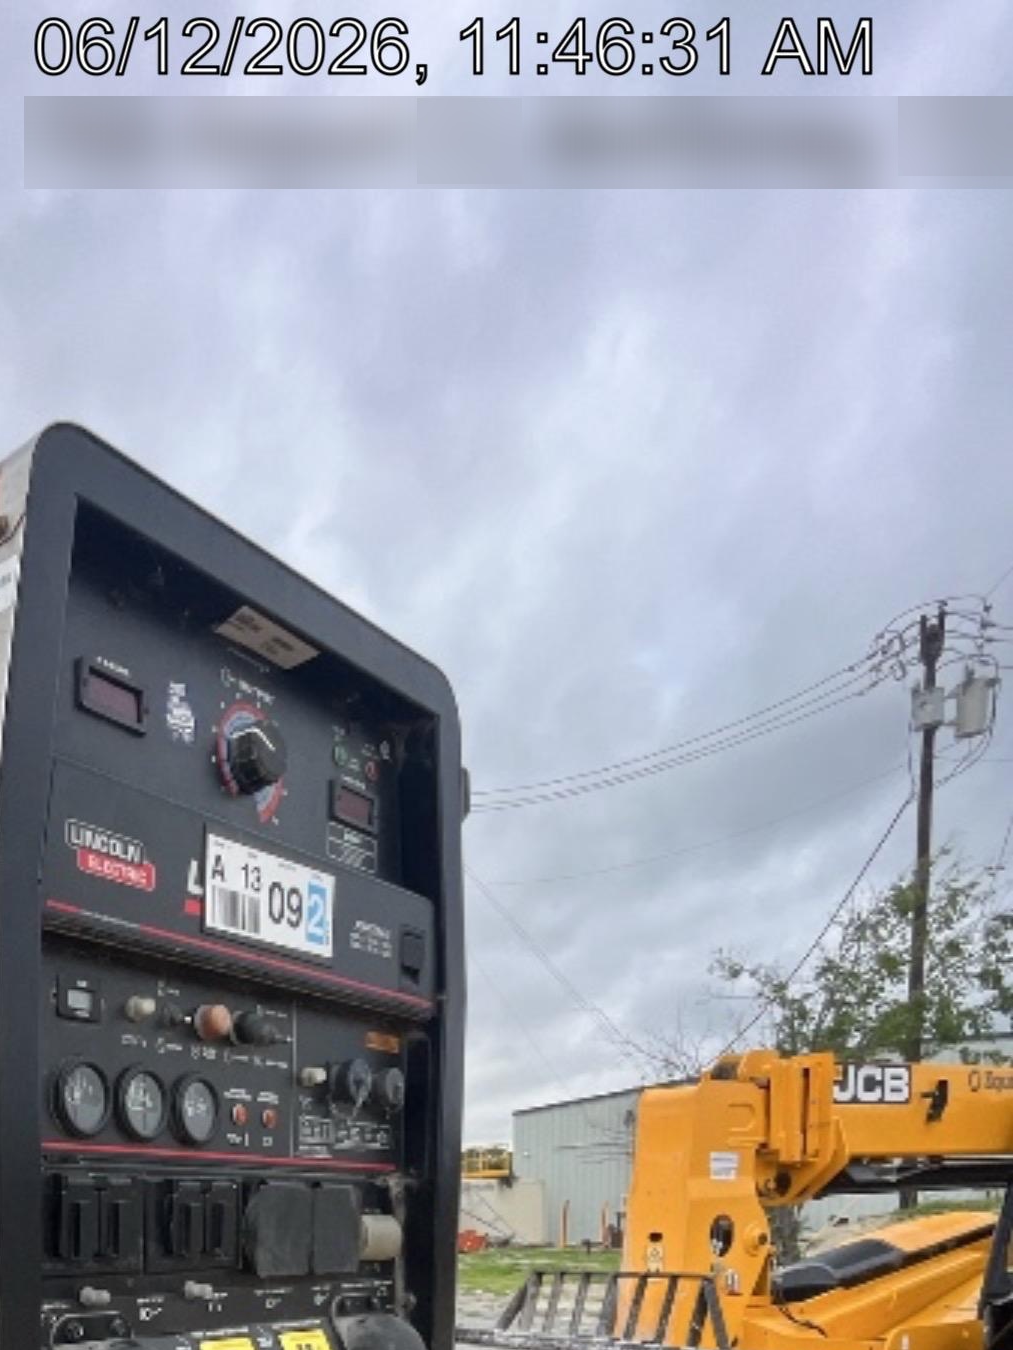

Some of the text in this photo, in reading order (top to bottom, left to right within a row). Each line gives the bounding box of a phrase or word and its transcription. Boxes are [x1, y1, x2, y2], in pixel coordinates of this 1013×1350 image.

[70, 823, 141, 865] LINCOLN
[211, 854, 226, 882] A
[240, 862, 262, 892] 13
[833, 1063, 910, 1103] JCB
